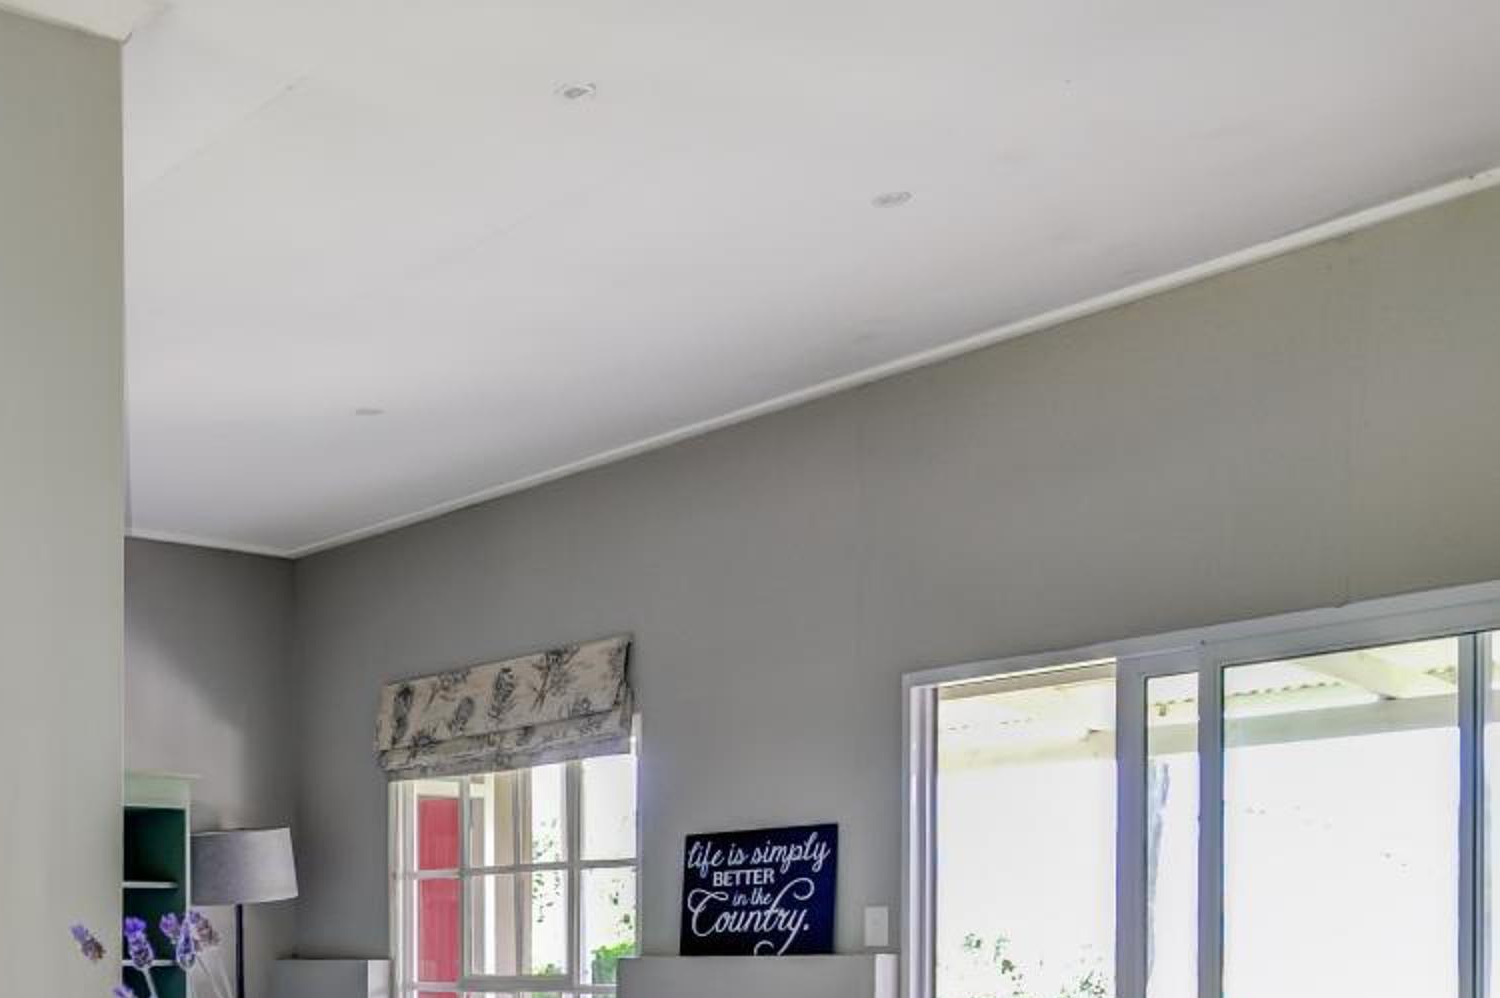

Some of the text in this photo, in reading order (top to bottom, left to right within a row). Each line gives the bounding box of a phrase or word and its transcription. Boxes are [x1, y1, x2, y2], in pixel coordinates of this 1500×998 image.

[687, 832, 831, 879] life is simply
[713, 867, 775, 887] BETTER
[732, 887, 773, 906] in the
[687, 877, 816, 956] Country.
